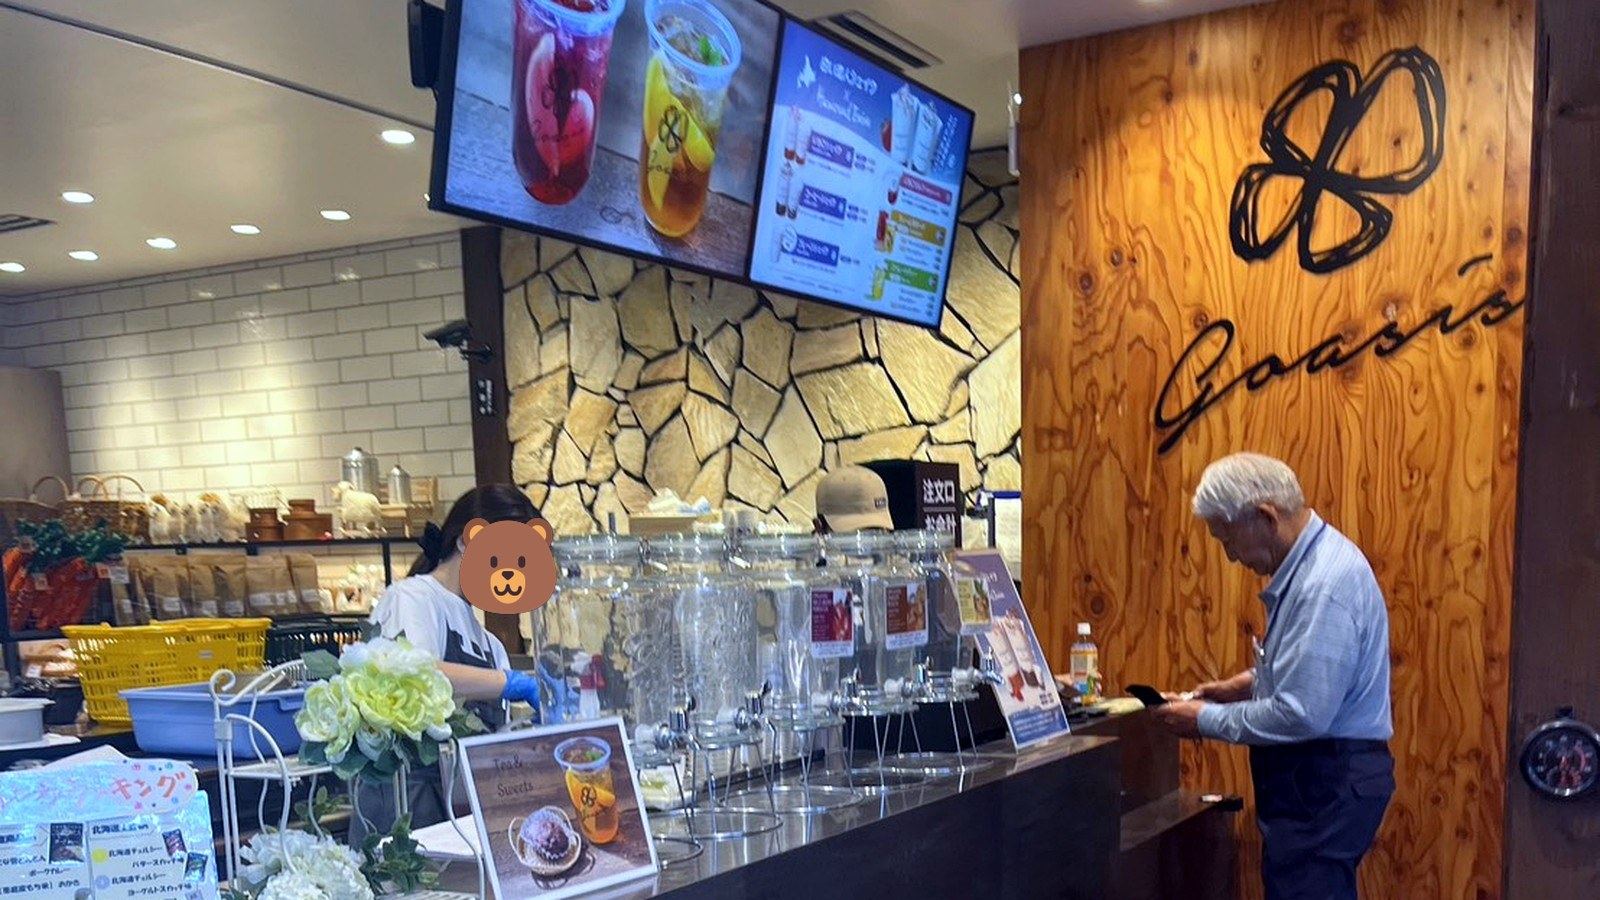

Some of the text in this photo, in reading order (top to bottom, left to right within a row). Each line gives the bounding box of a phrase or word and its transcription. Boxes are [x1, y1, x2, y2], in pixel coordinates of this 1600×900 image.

[922, 478, 955, 504] 注文口
[497, 782, 534, 797] Sweets
